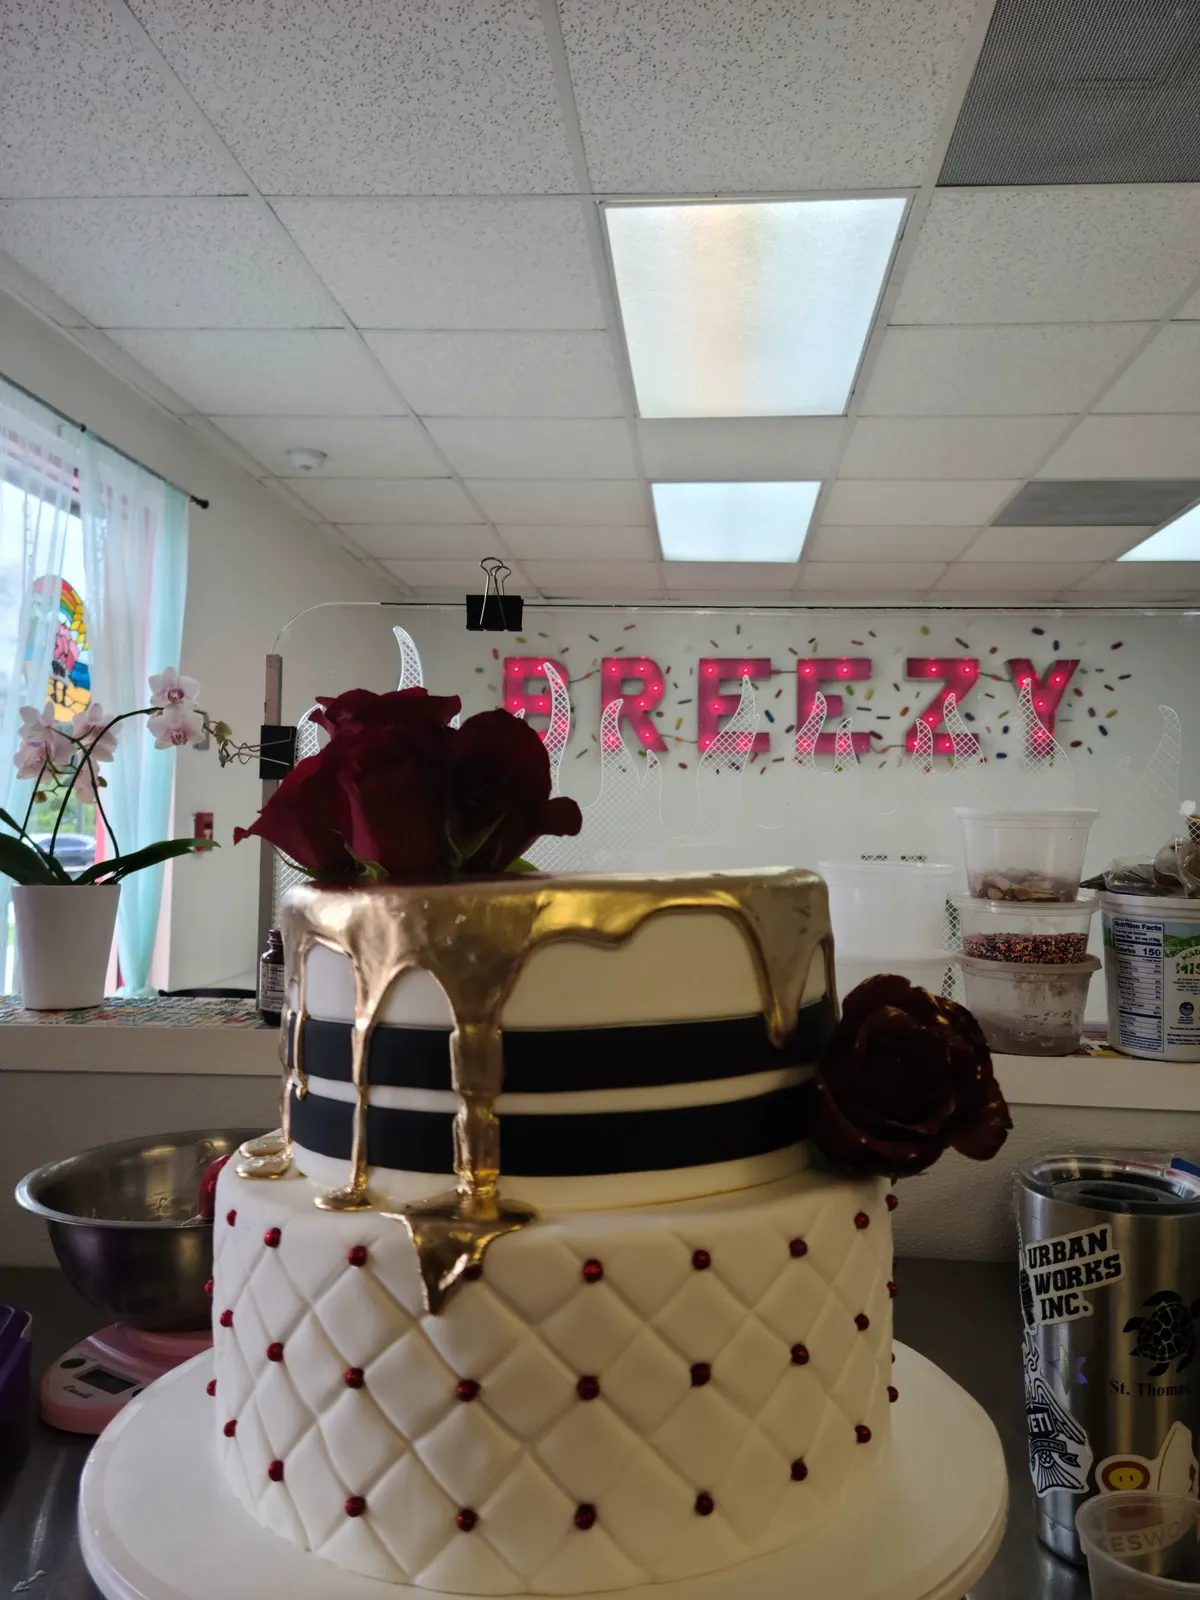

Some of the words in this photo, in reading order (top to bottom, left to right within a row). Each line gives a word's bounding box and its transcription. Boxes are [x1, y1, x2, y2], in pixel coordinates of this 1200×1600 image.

[504, 656, 1080, 755] BREEZY
[1114, 921, 1140, 930] Nutrition
[1143, 948, 1161, 957] 150
[1028, 1228, 1108, 1269] URBAN
[1034, 1254, 1121, 1296] WORKS
[1040, 1293, 1089, 1320] INC.
[1109, 1379, 1130, 1396] St.
